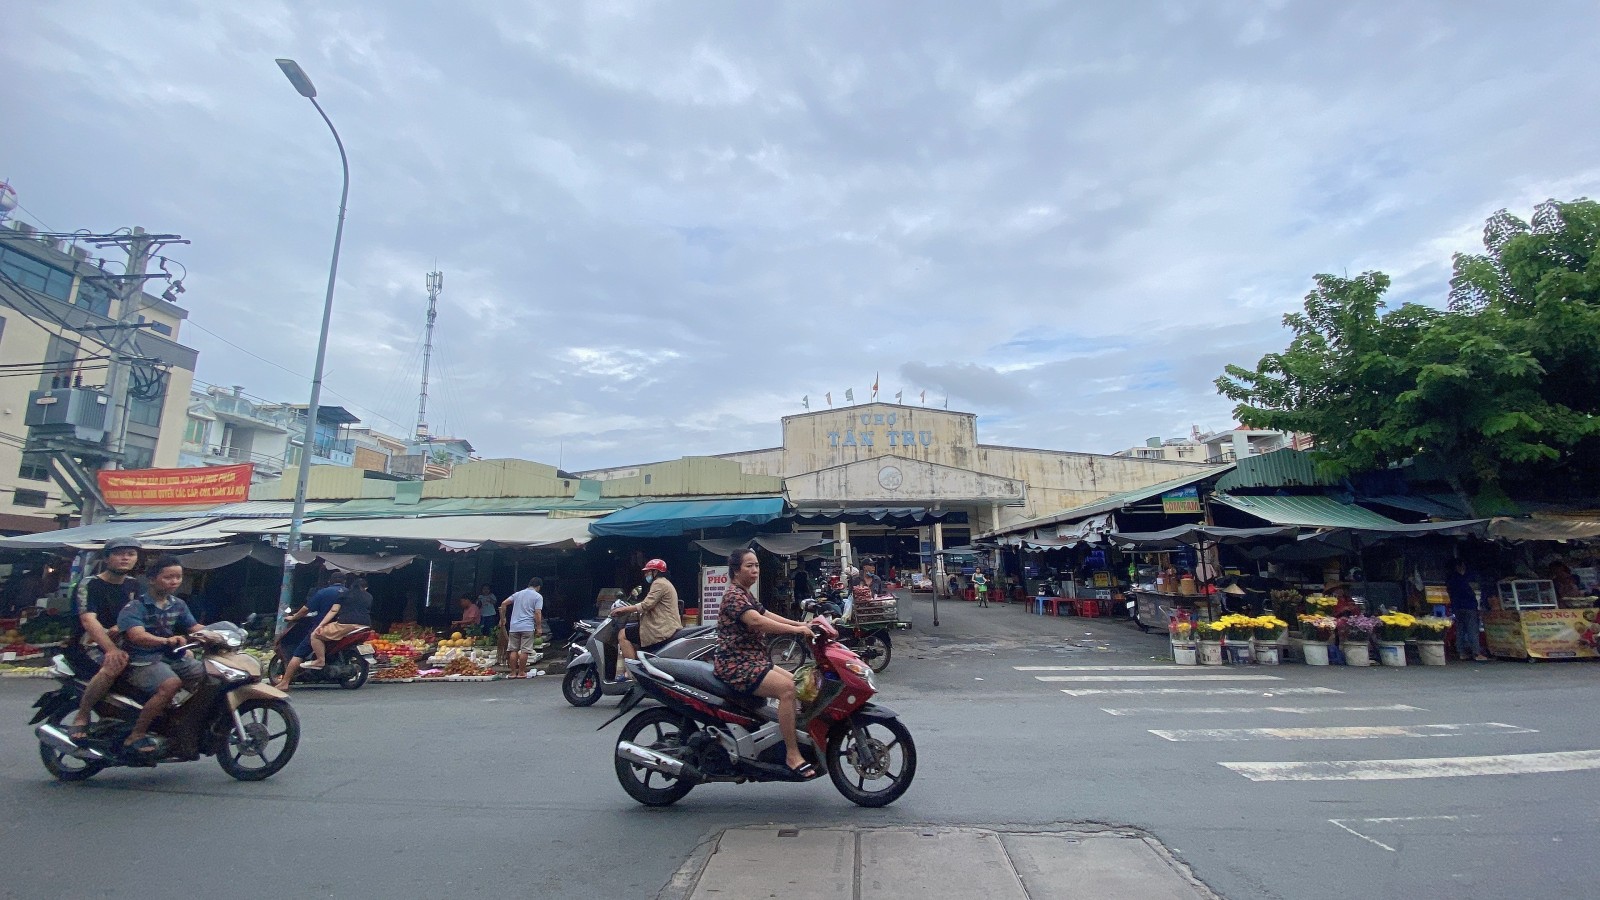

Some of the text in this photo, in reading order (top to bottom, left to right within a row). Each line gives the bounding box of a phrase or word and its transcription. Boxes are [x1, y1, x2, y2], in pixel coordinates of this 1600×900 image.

[860, 411, 897, 428] CHỢ
[827, 427, 932, 449] TÂN TRỤ
